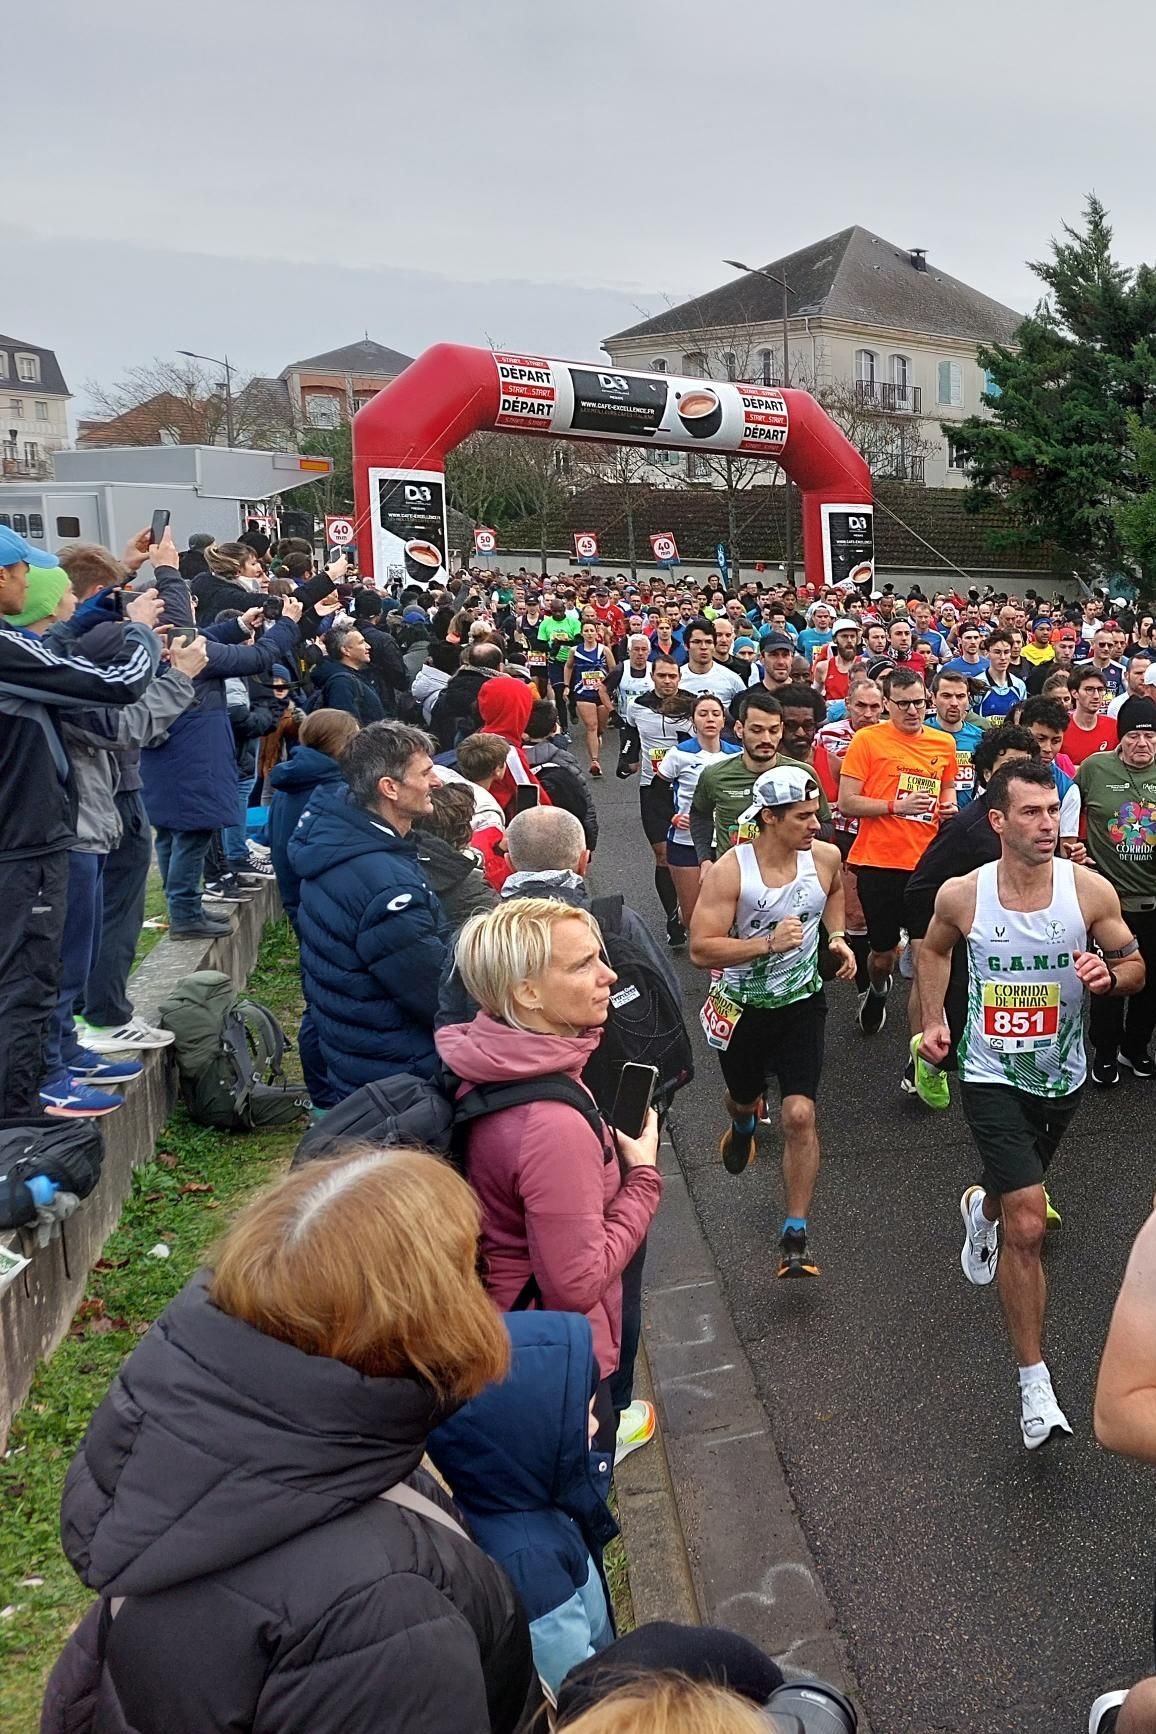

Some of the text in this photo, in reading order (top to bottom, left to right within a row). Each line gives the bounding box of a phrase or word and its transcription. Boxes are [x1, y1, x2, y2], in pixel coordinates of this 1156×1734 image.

[500, 365, 551, 384] DÉPART
[502, 397, 553, 416] DÉPART
[743, 396, 784, 412] DÉPART
[744, 425, 786, 441] DÉPART
[333, 525, 349, 535] 40
[480, 536, 491, 544] 50
[581, 540, 593, 549] 45
[658, 541, 670, 551] 40
[988, 952, 1069, 972] G.A.N.G
[994, 985, 1049, 997] CORRIDA
[995, 996, 1048, 1007] DE THIAIS
[707, 999, 730, 1036] 760
[994, 1011, 1044, 1034] 851
